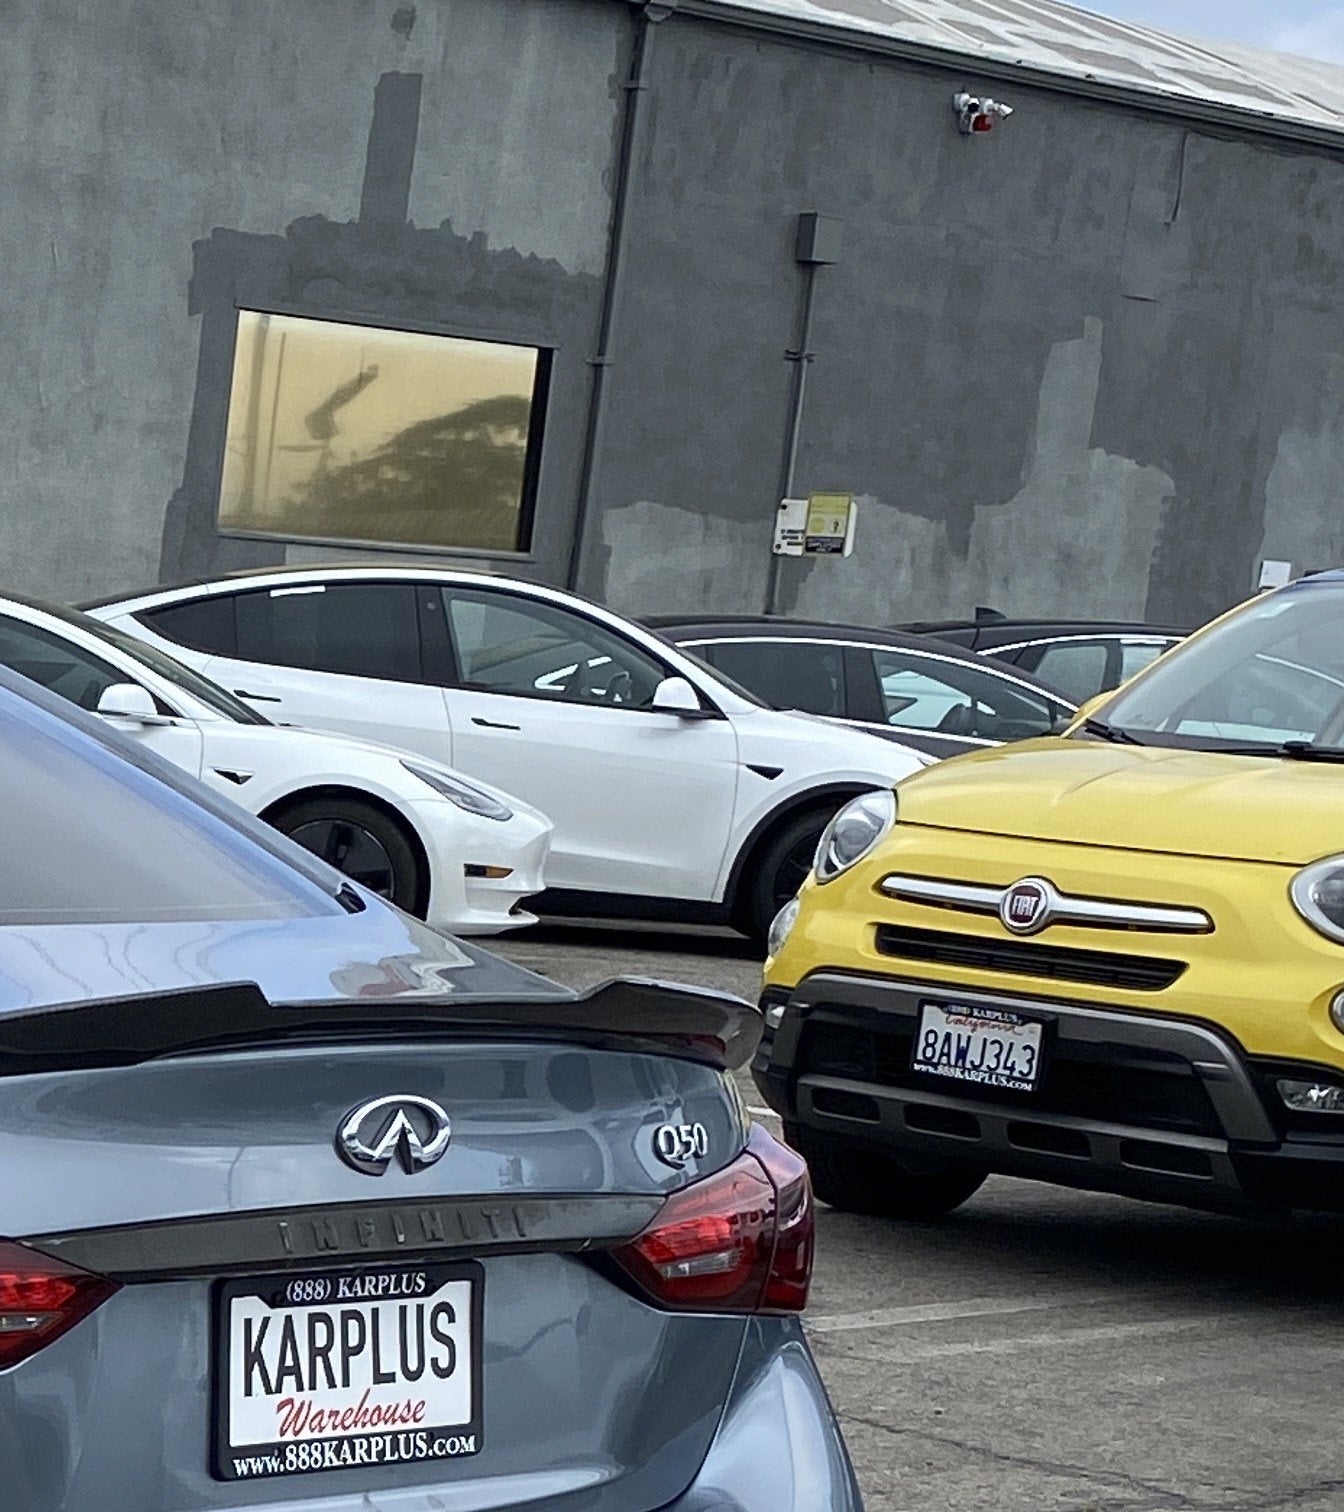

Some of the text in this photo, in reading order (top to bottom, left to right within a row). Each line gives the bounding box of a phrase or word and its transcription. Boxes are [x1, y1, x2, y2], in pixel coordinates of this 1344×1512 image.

[1012, 895, 1039, 916] FIAT
[922, 1028, 1036, 1078] 8AWJ343
[654, 1122, 708, 1170] Q50
[279, 1204, 527, 1254] INFINITI
[286, 1272, 427, 1301] (888) KARPLUS
[243, 1301, 457, 1398] KARPLUS
[275, 1387, 427, 1438] Warehouse
